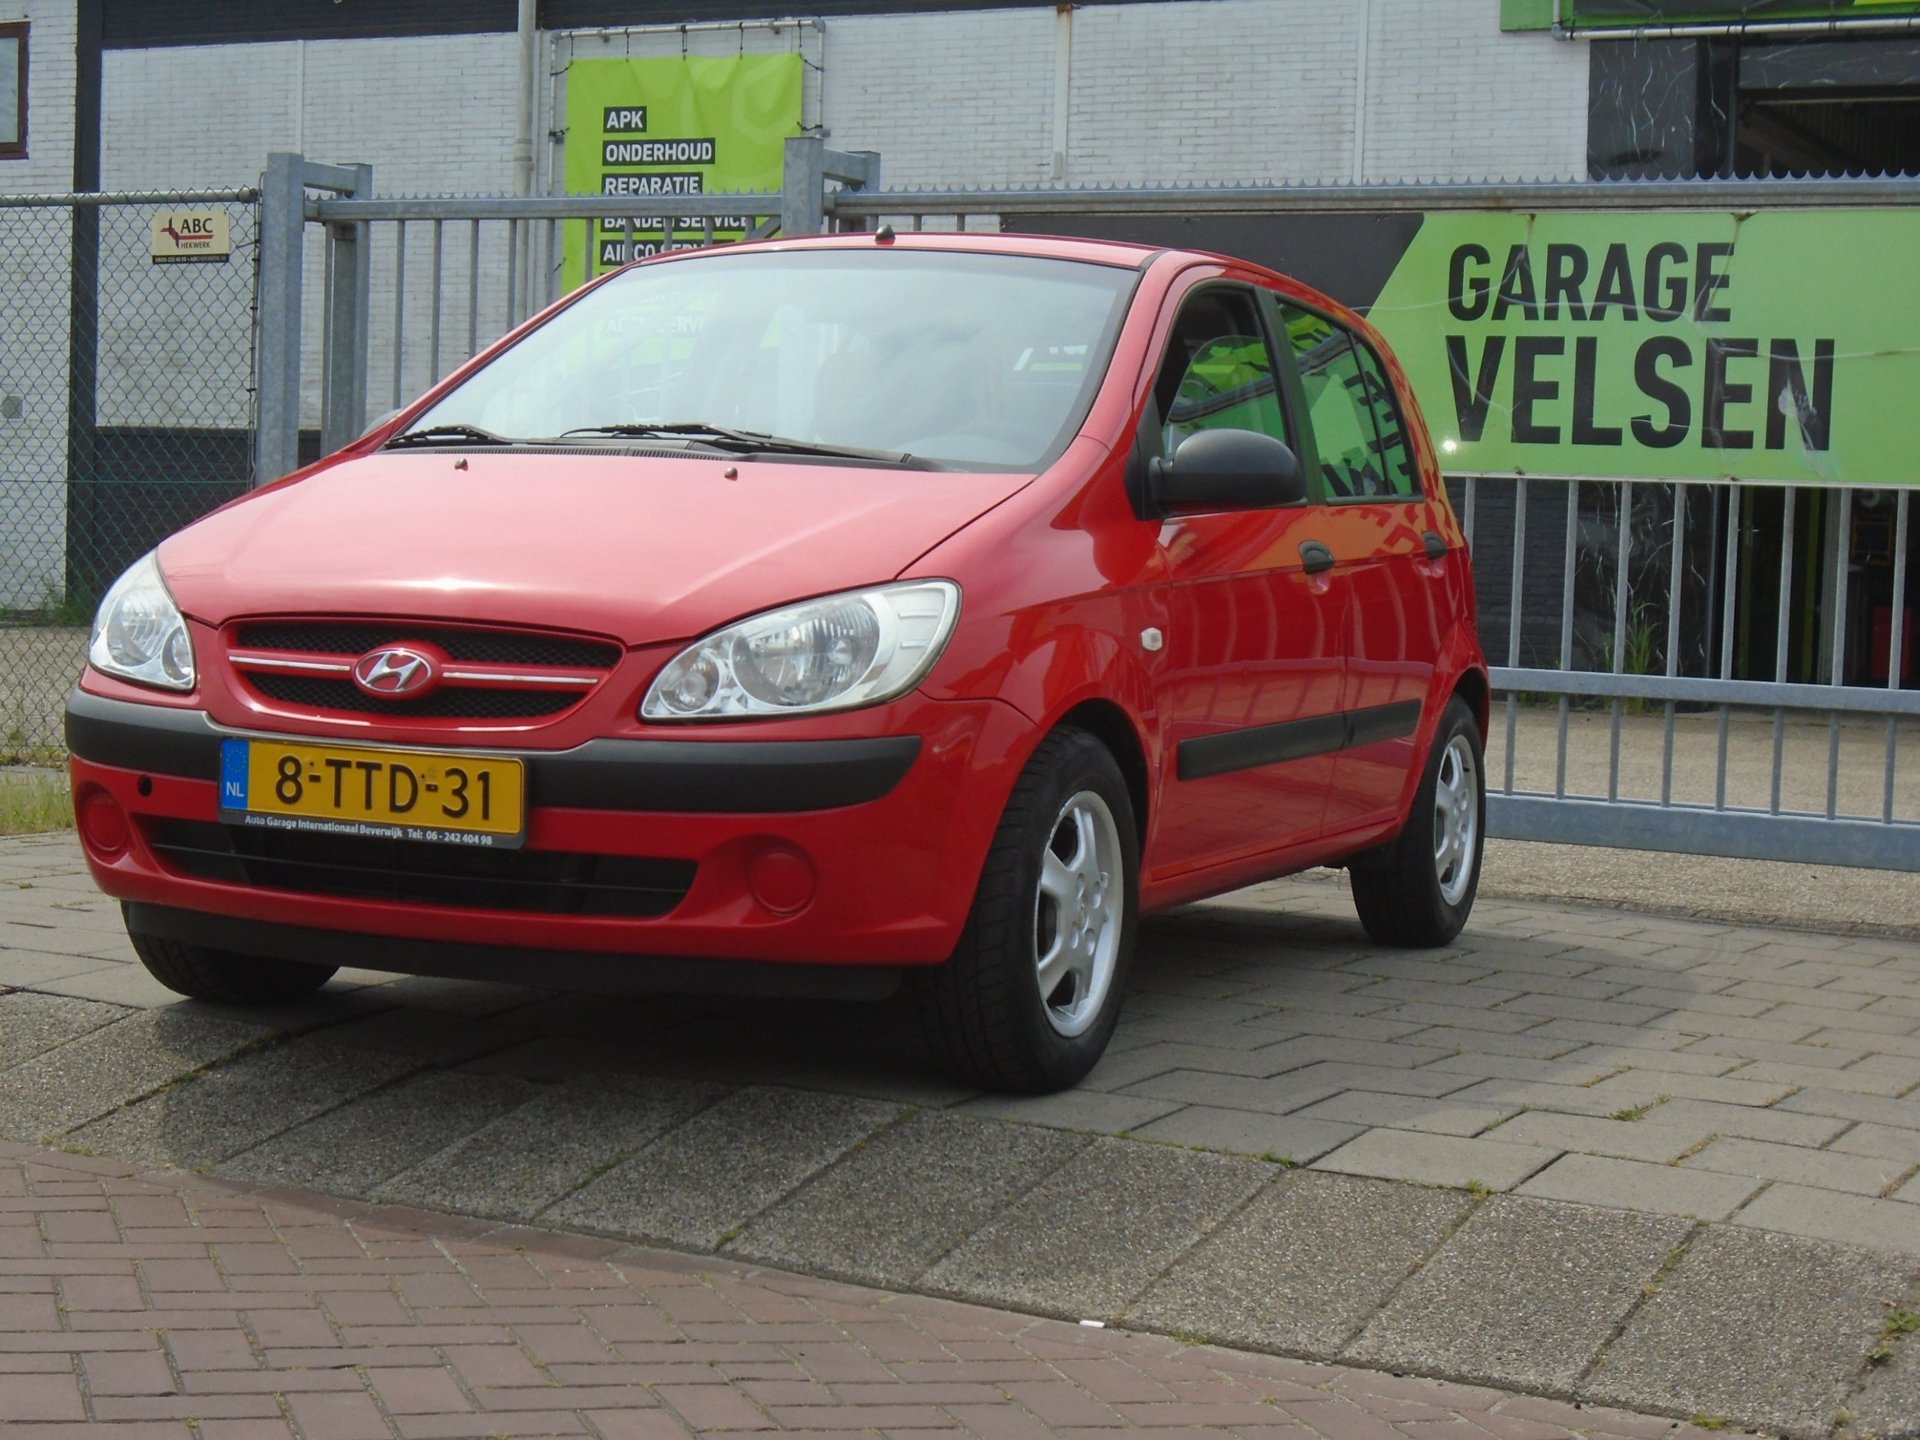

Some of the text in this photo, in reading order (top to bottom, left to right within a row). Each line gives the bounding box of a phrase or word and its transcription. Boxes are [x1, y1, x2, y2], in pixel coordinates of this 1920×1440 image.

[606, 110, 643, 128] APK
[605, 142, 712, 162] ONDERHOUD
[604, 176, 700, 195] REPARATIE
[180, 217, 213, 233] ABC
[679, 216, 747, 227] SEVIC
[180, 241, 211, 249] HEKWERK
[603, 243, 654, 262] AICO
[1447, 242, 1735, 322] GARAGE
[1445, 335, 1835, 451] VELSEN
[226, 755, 491, 821] NL 8-TTD-31
[245, 815, 265, 825] Auto
[267, 816, 297, 829] Garage
[298, 819, 358, 833] Internationaal
[360, 824, 403, 839] Beverwijk
[426, 830, 437, 840] 06
[480, 836, 492, 845] 98
